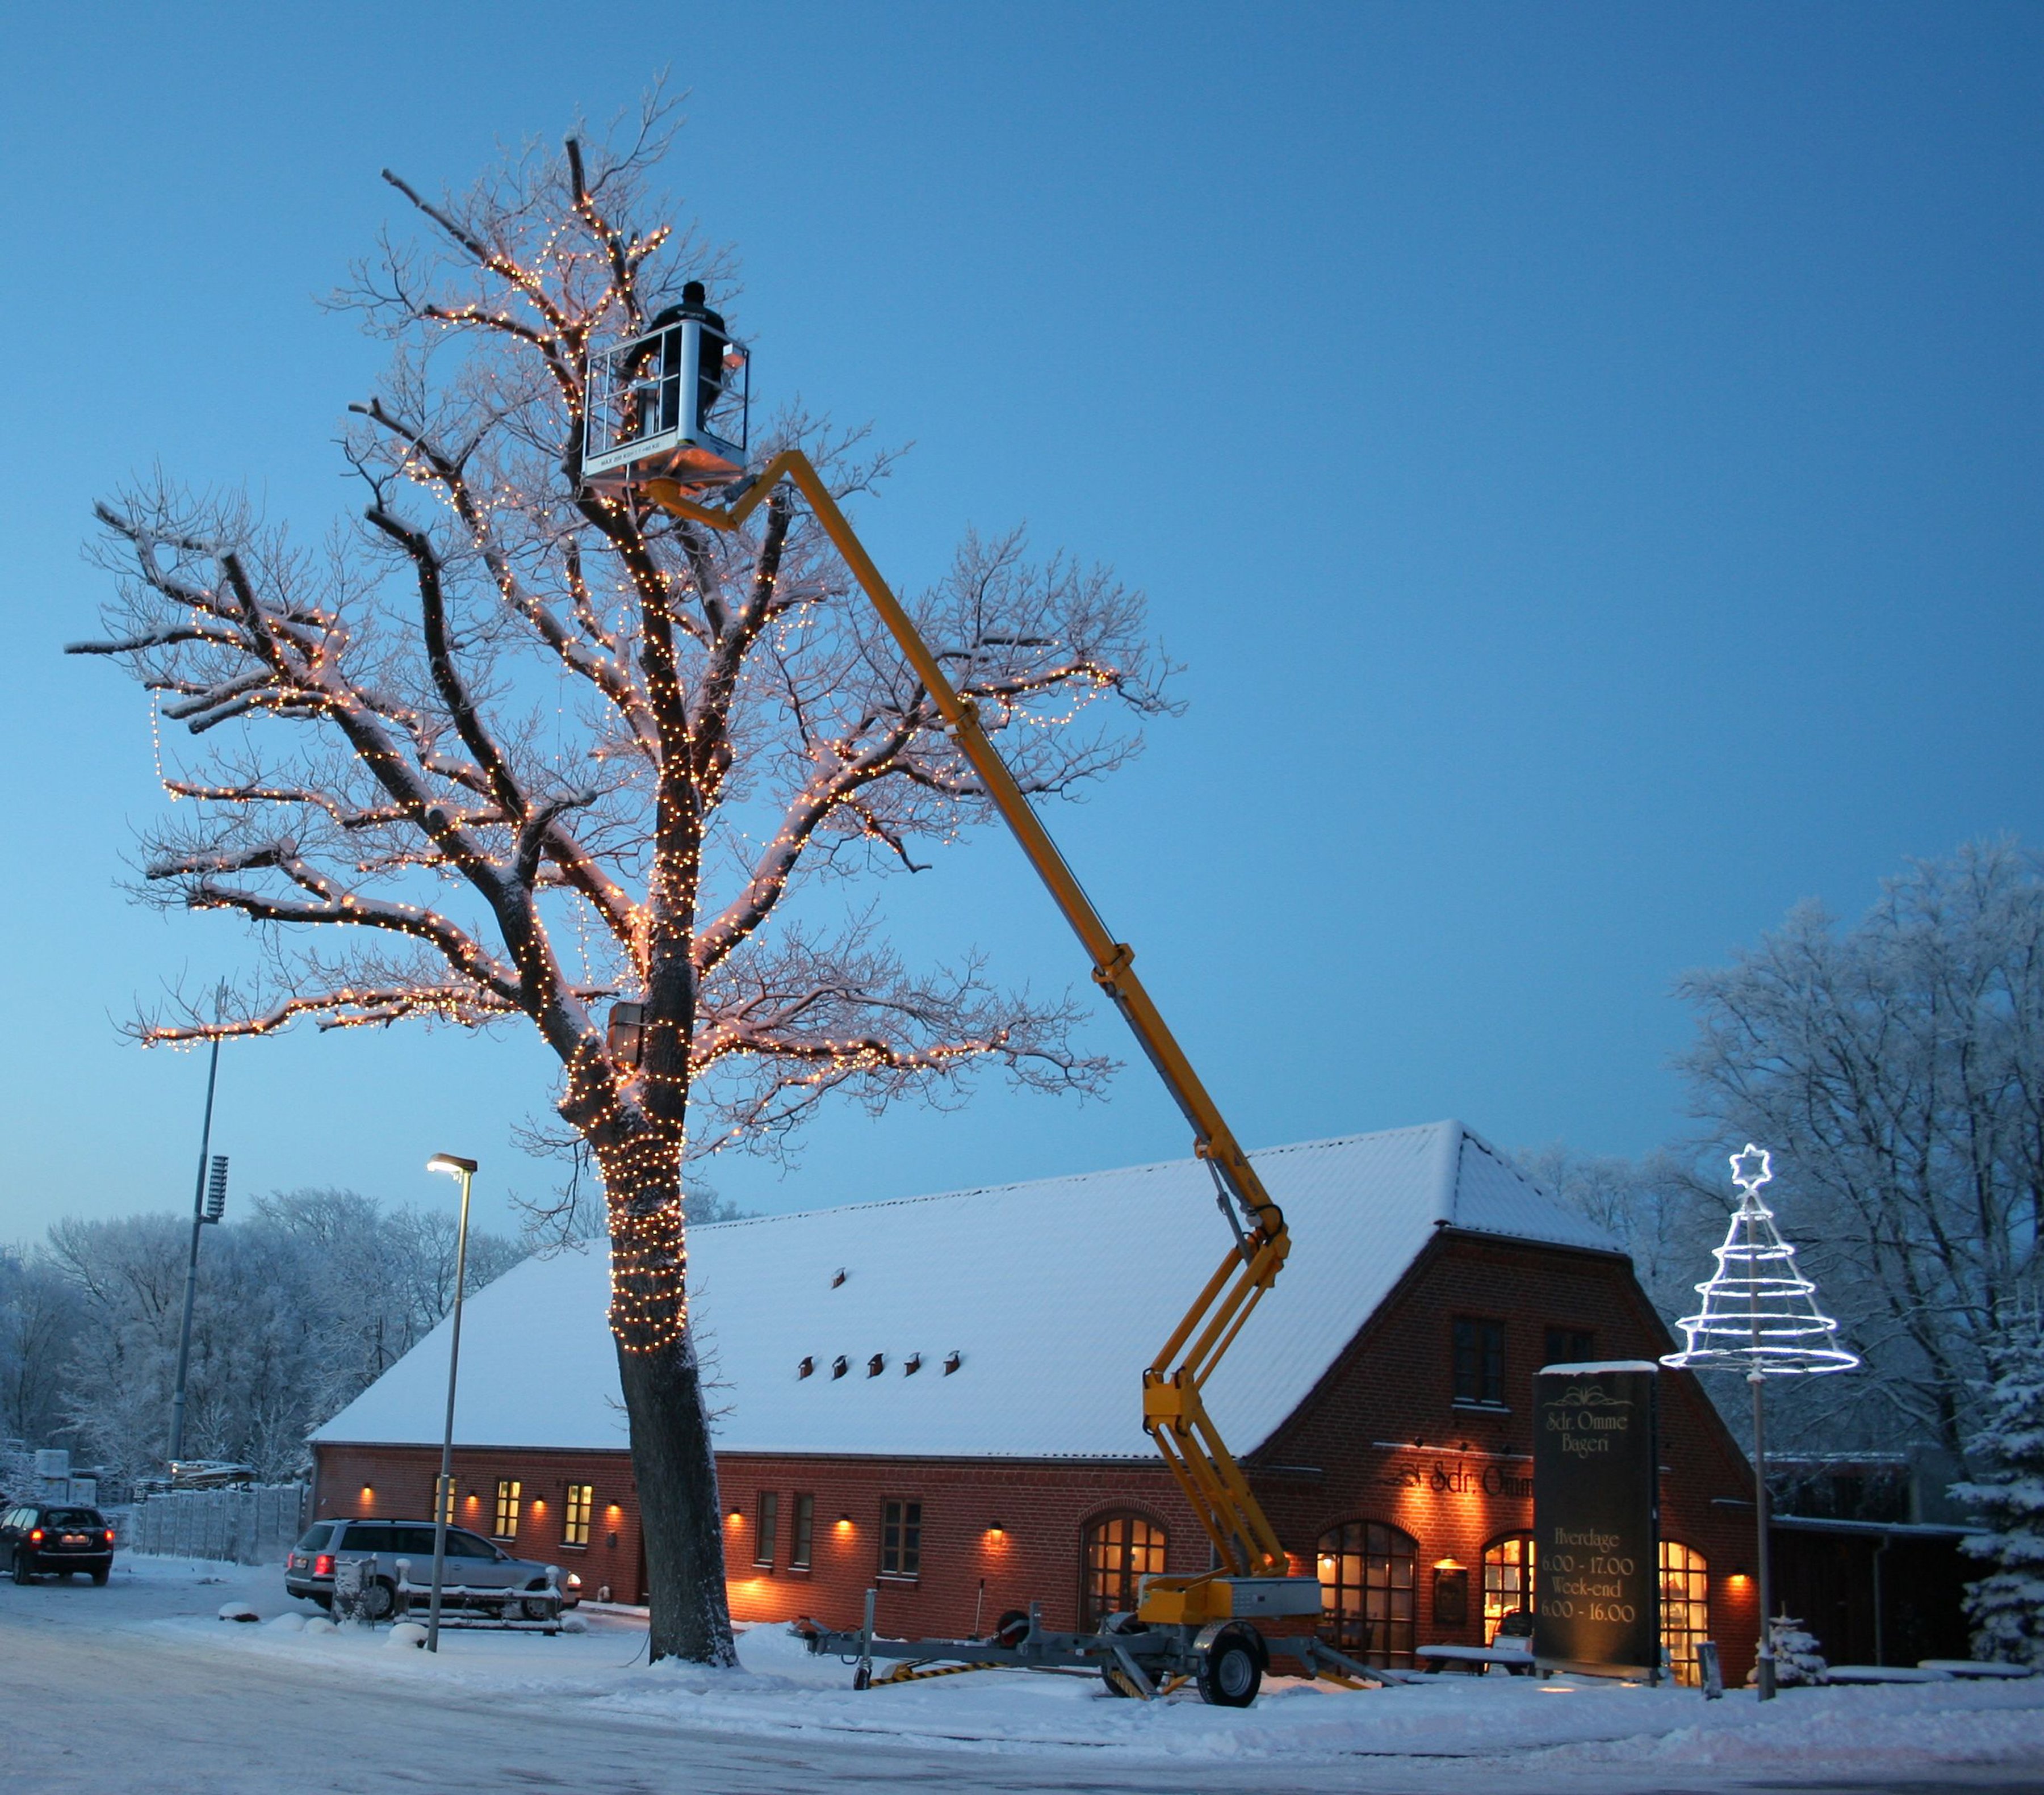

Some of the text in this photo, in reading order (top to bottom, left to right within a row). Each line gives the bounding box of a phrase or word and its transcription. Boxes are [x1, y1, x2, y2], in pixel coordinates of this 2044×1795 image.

[1546, 1411, 1628, 1431] Sdr. Omme
[1562, 1433, 1609, 1459] Bageri
[1430, 1460, 1533, 1497] Sdr. Omm
[1555, 1527, 1620, 1553] Hverdage
[1542, 1555, 1574, 1572] 6.00
[1590, 1557, 1634, 1575] 17.00
[1552, 1576, 1622, 1597] Week-end
[1542, 1600, 1573, 1618] 6.00
[1590, 1603, 1635, 1622] 16.00
